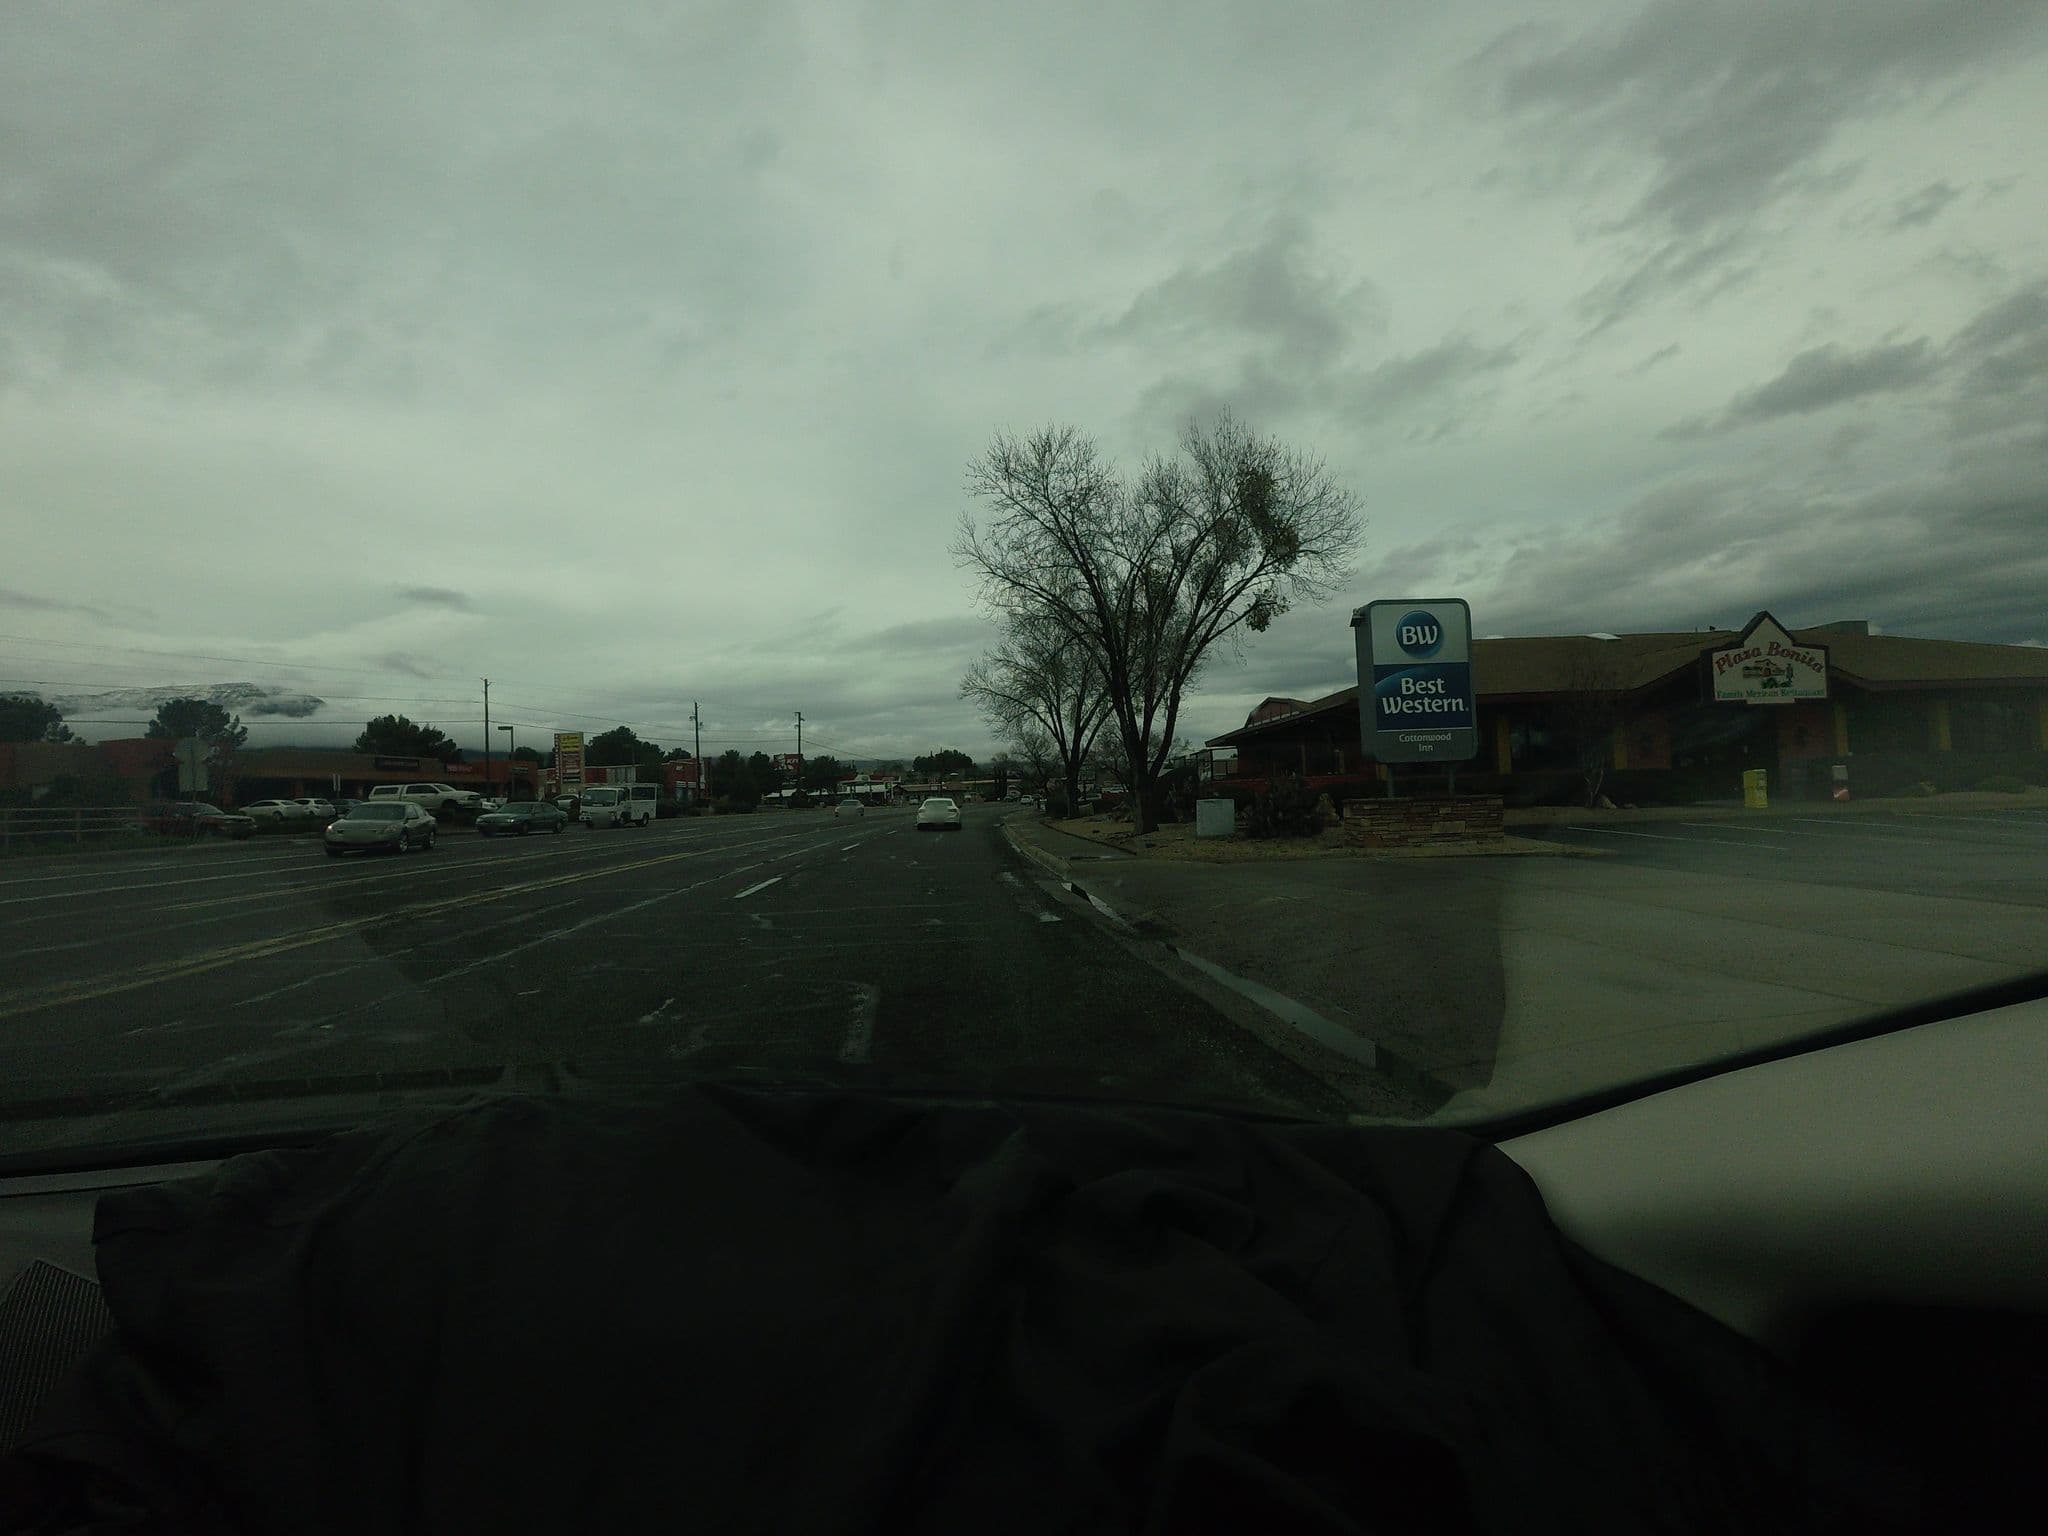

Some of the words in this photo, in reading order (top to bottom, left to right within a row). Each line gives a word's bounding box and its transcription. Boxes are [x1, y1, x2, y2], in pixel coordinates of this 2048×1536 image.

[1402, 626, 1438, 645] BW
[1715, 648, 1761, 675] Plaza
[1767, 641, 1823, 673] Bonita
[1401, 677, 1446, 695] Best
[1399, 733, 1451, 743] Cottonwood
[1418, 744, 1434, 752] Inn
